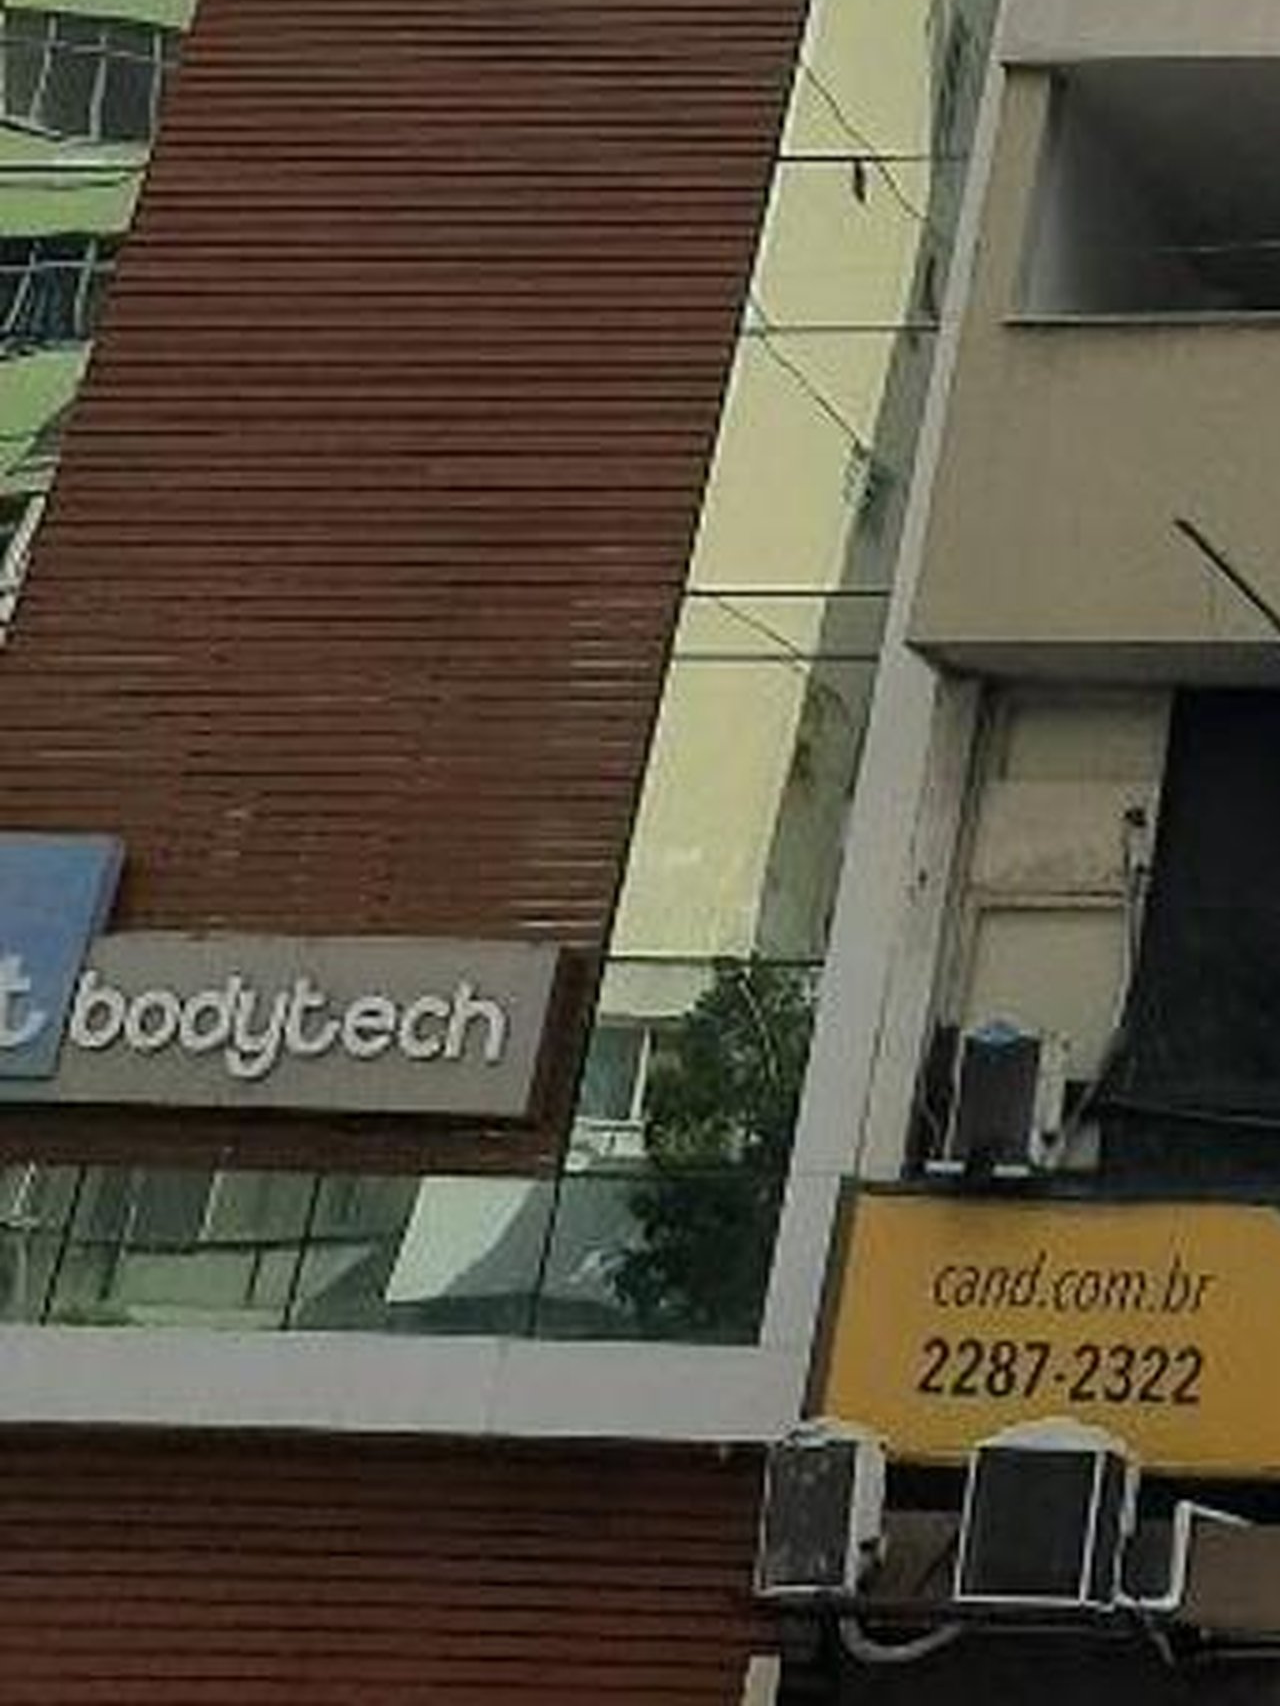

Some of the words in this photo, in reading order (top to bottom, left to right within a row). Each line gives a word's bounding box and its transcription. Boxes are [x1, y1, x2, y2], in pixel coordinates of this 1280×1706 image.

[69, 969, 508, 1079] bodytech
[932, 1250, 1217, 1313] cand.com.br
[918, 1338, 1203, 1405] 2287-2322
